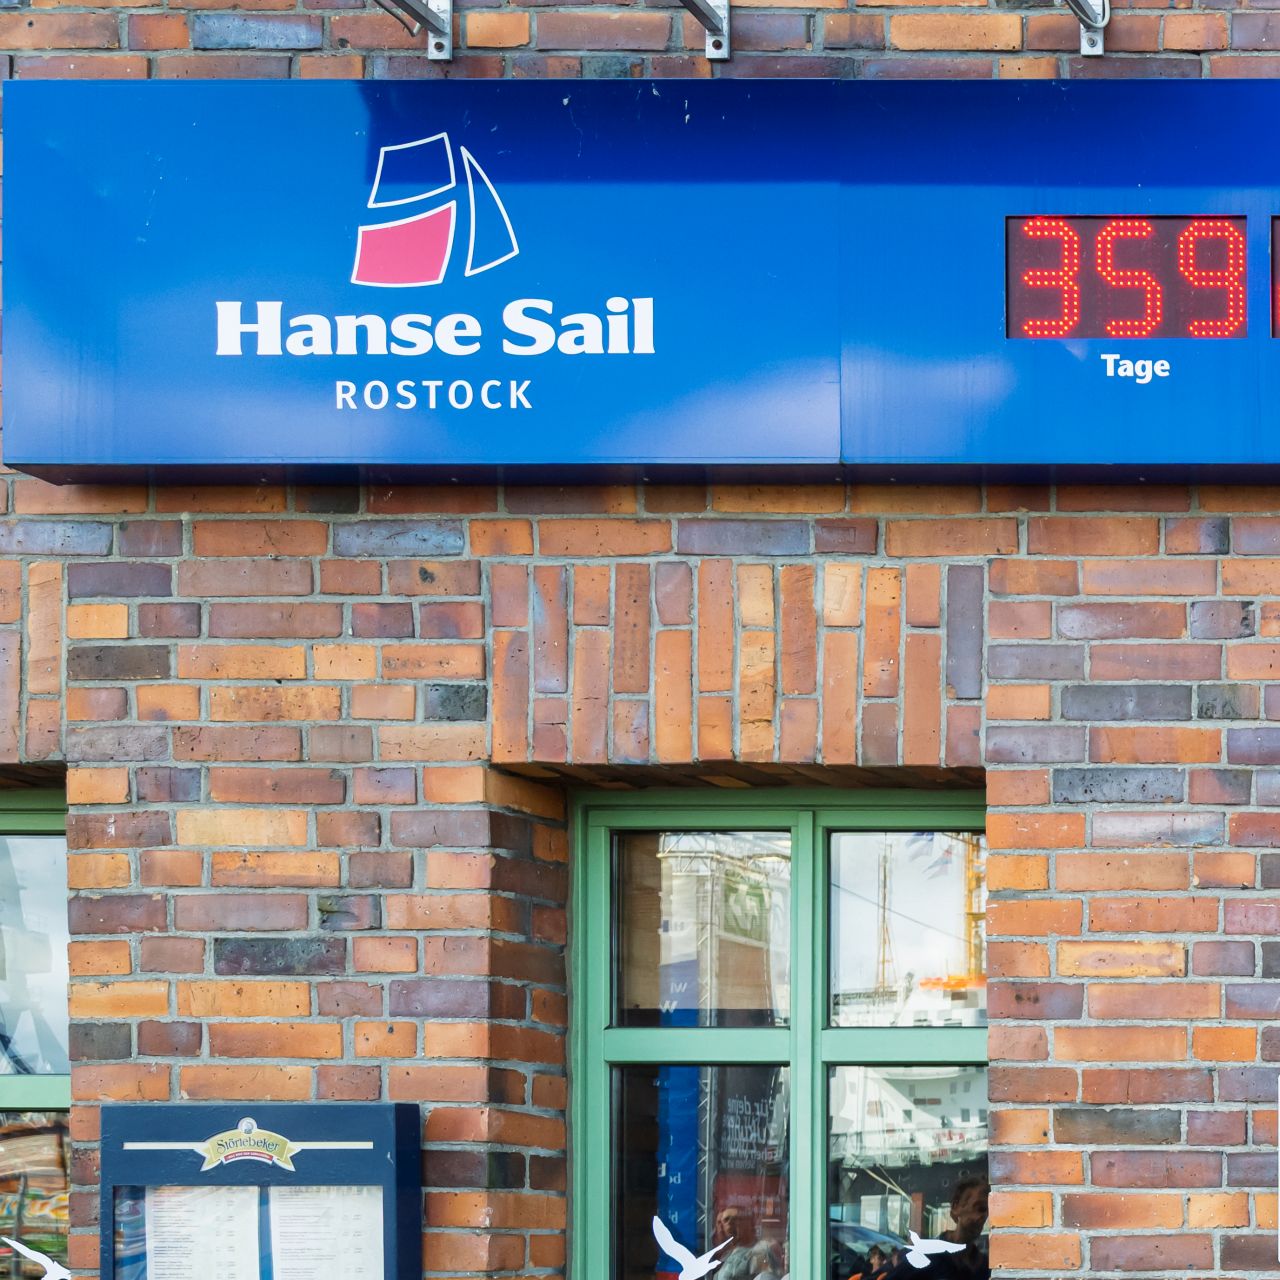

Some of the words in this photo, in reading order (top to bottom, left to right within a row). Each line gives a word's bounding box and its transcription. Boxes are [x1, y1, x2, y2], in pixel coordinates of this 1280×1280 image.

[1021, 217, 1246, 337] 359
[215, 301, 482, 356] Hanse
[502, 296, 655, 356] Sail
[1100, 354, 1170, 384] Tage
[336, 379, 532, 410] ROSTOCK
[216, 1136, 280, 1155] Störtebeker
